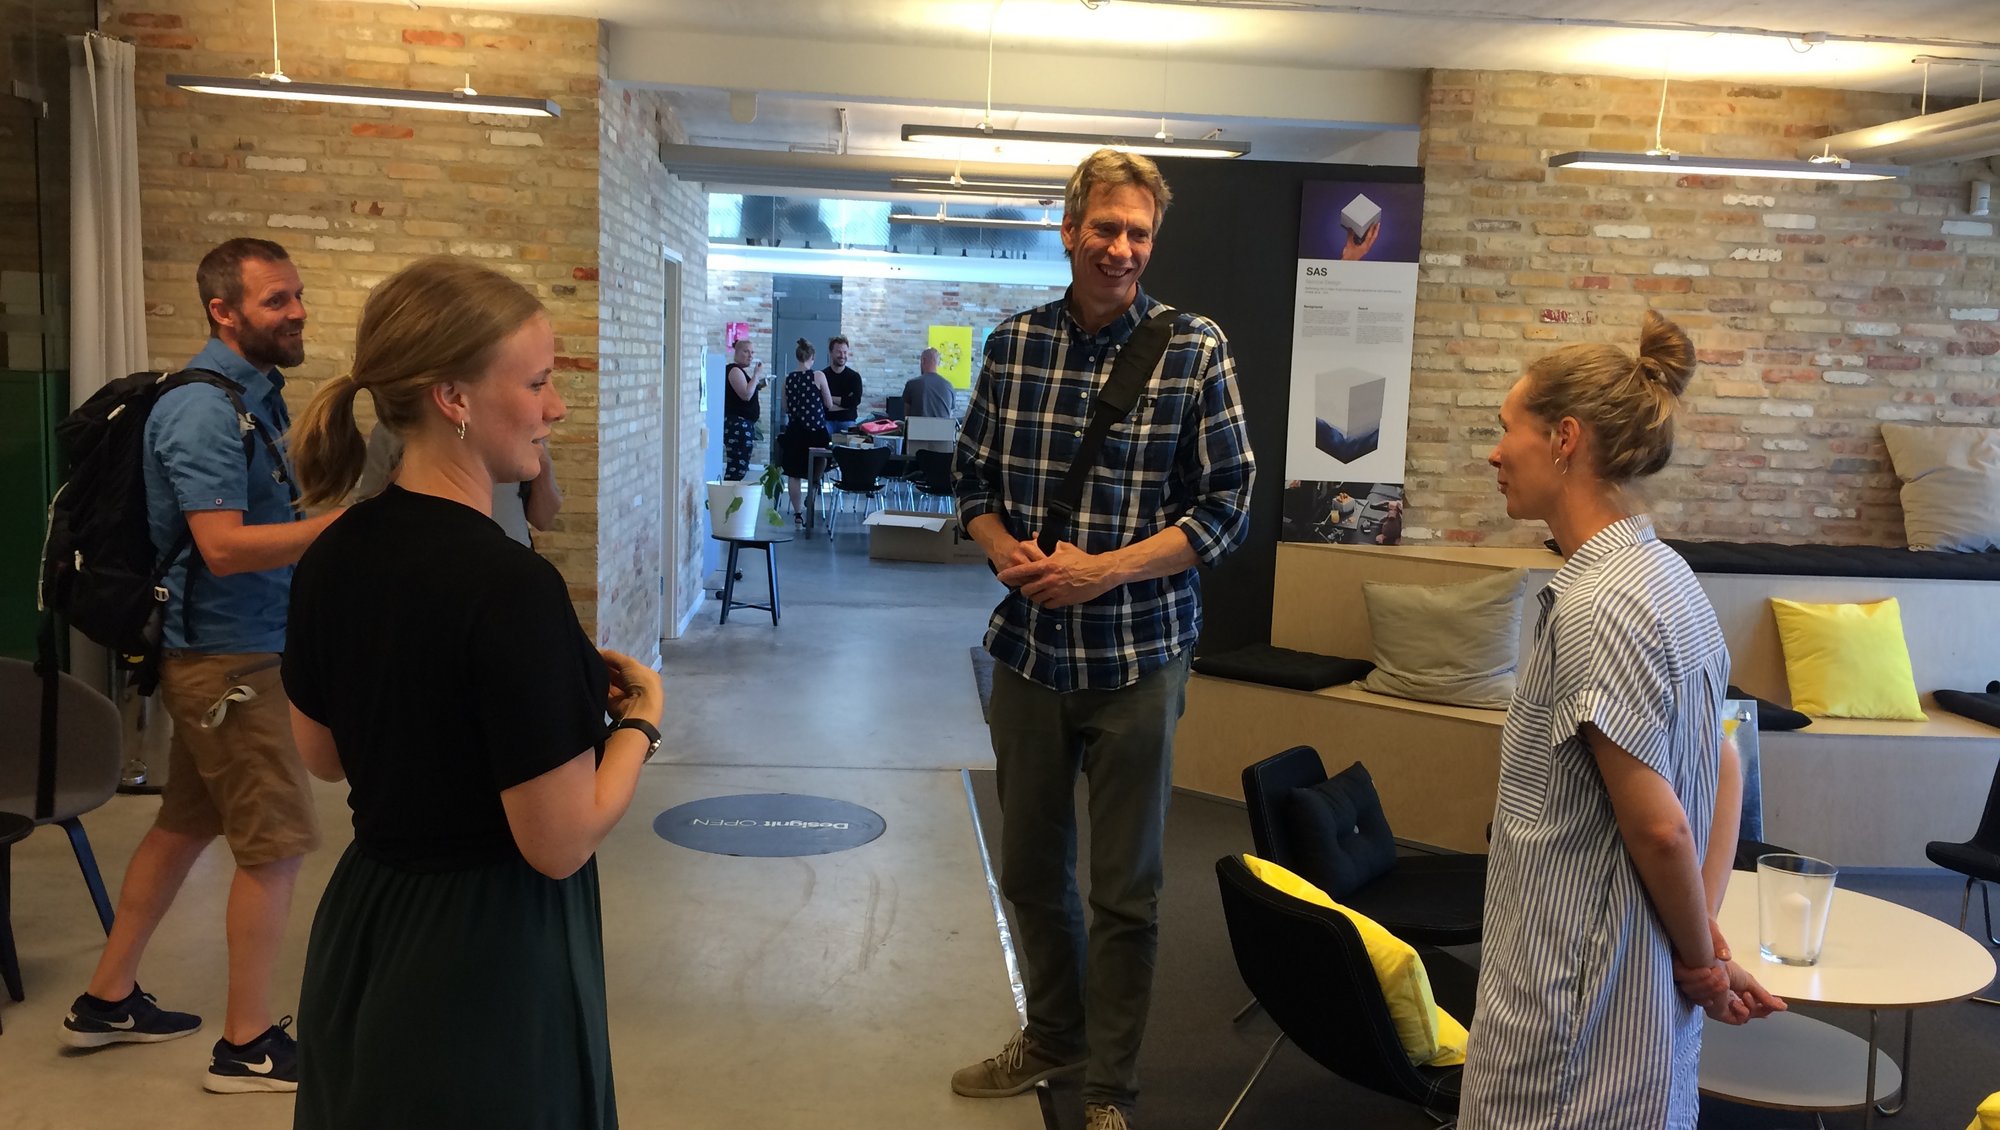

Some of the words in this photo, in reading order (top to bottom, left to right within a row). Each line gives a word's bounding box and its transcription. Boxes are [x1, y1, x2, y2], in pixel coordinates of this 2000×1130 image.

[1306, 267, 1327, 277] SAS
[692, 818, 757, 827] OPEN
[763, 820, 849, 830] Designit
